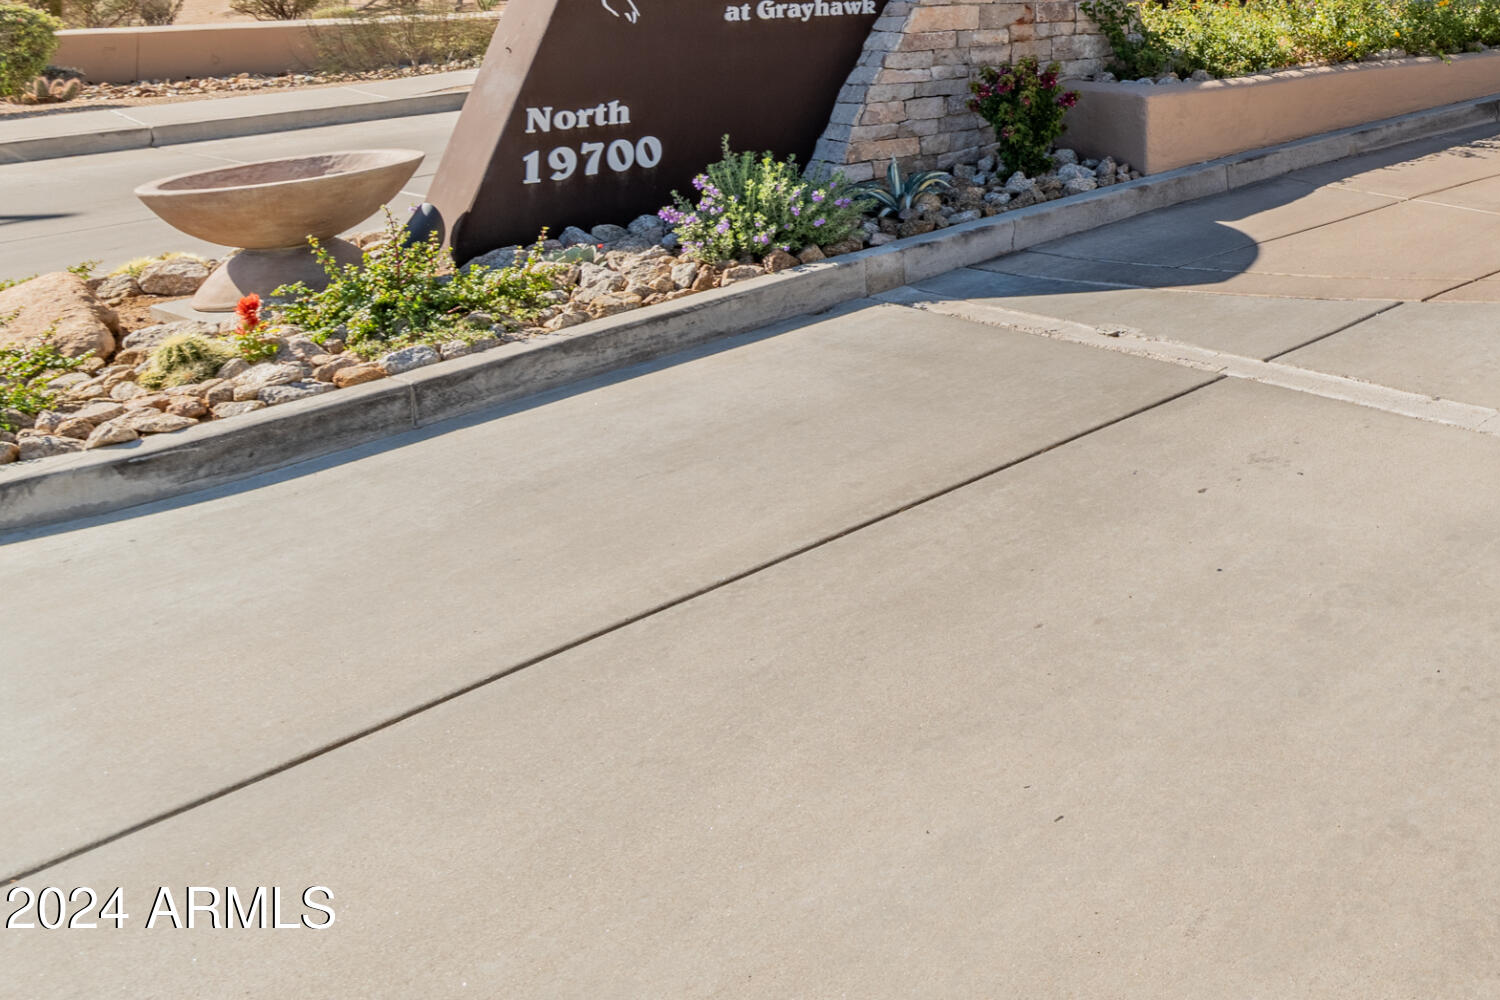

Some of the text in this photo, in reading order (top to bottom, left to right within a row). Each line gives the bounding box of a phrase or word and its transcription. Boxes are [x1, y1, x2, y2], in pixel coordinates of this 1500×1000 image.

[724, 3, 751, 21] at
[525, 100, 631, 134] North
[522, 135, 663, 184] 19700
